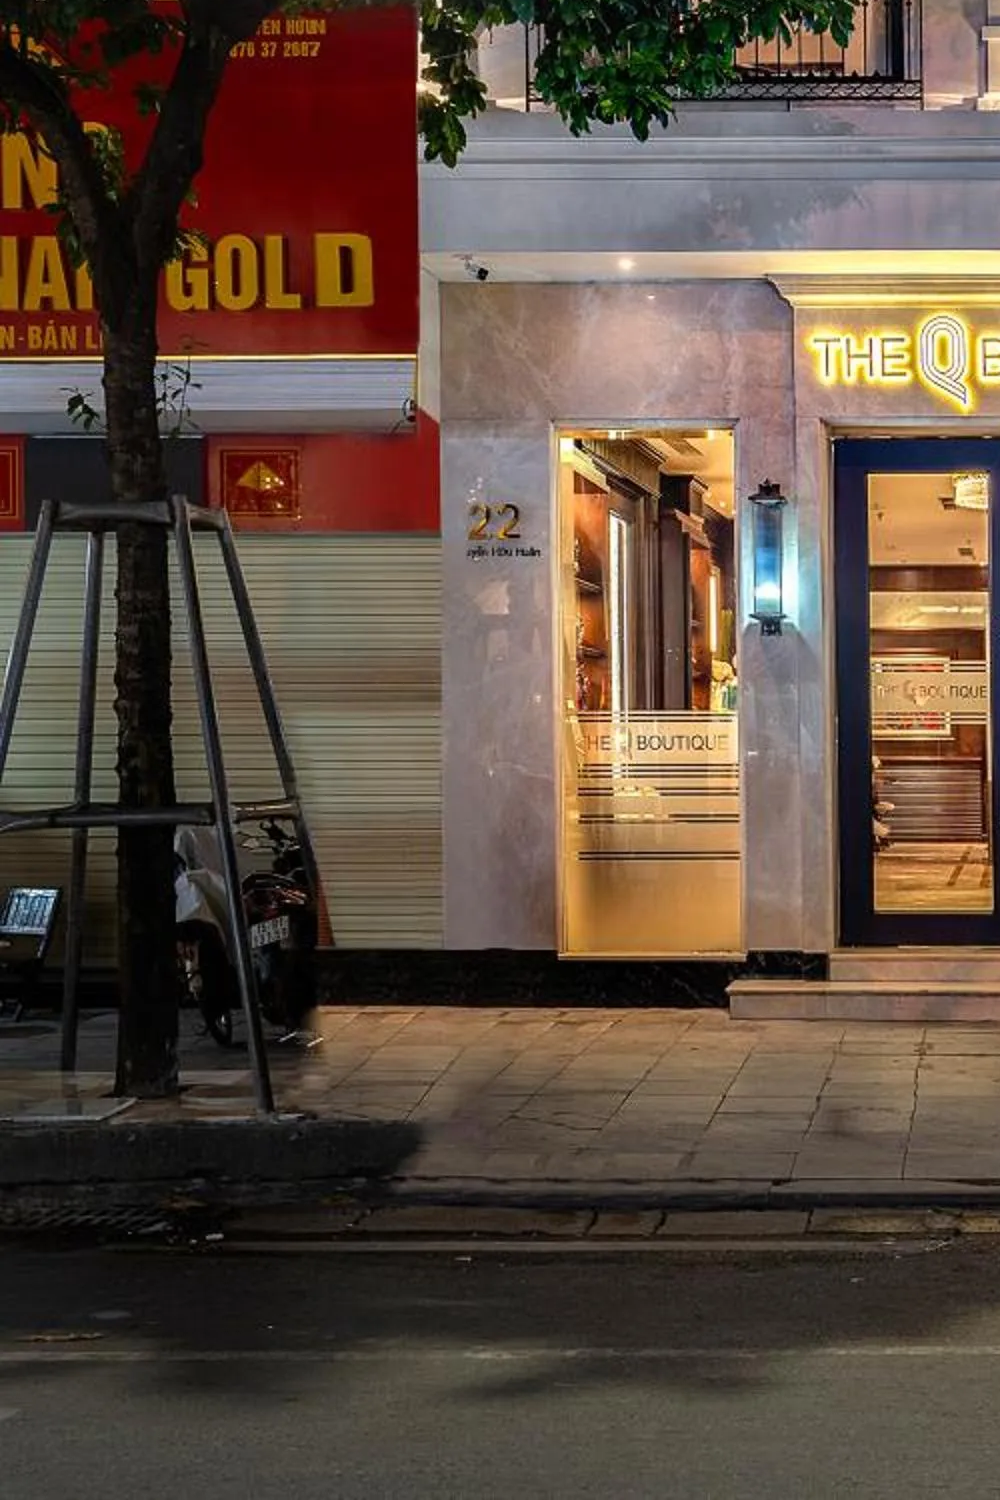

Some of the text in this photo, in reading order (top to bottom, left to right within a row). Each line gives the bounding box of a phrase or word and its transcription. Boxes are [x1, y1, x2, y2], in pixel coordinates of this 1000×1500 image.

[164, 232, 375, 311] GOLD
[812, 337, 908, 378] THE
[919, 315, 968, 403] Q
[467, 502, 521, 540] 22
[636, 734, 729, 752] BOUTIQUE
